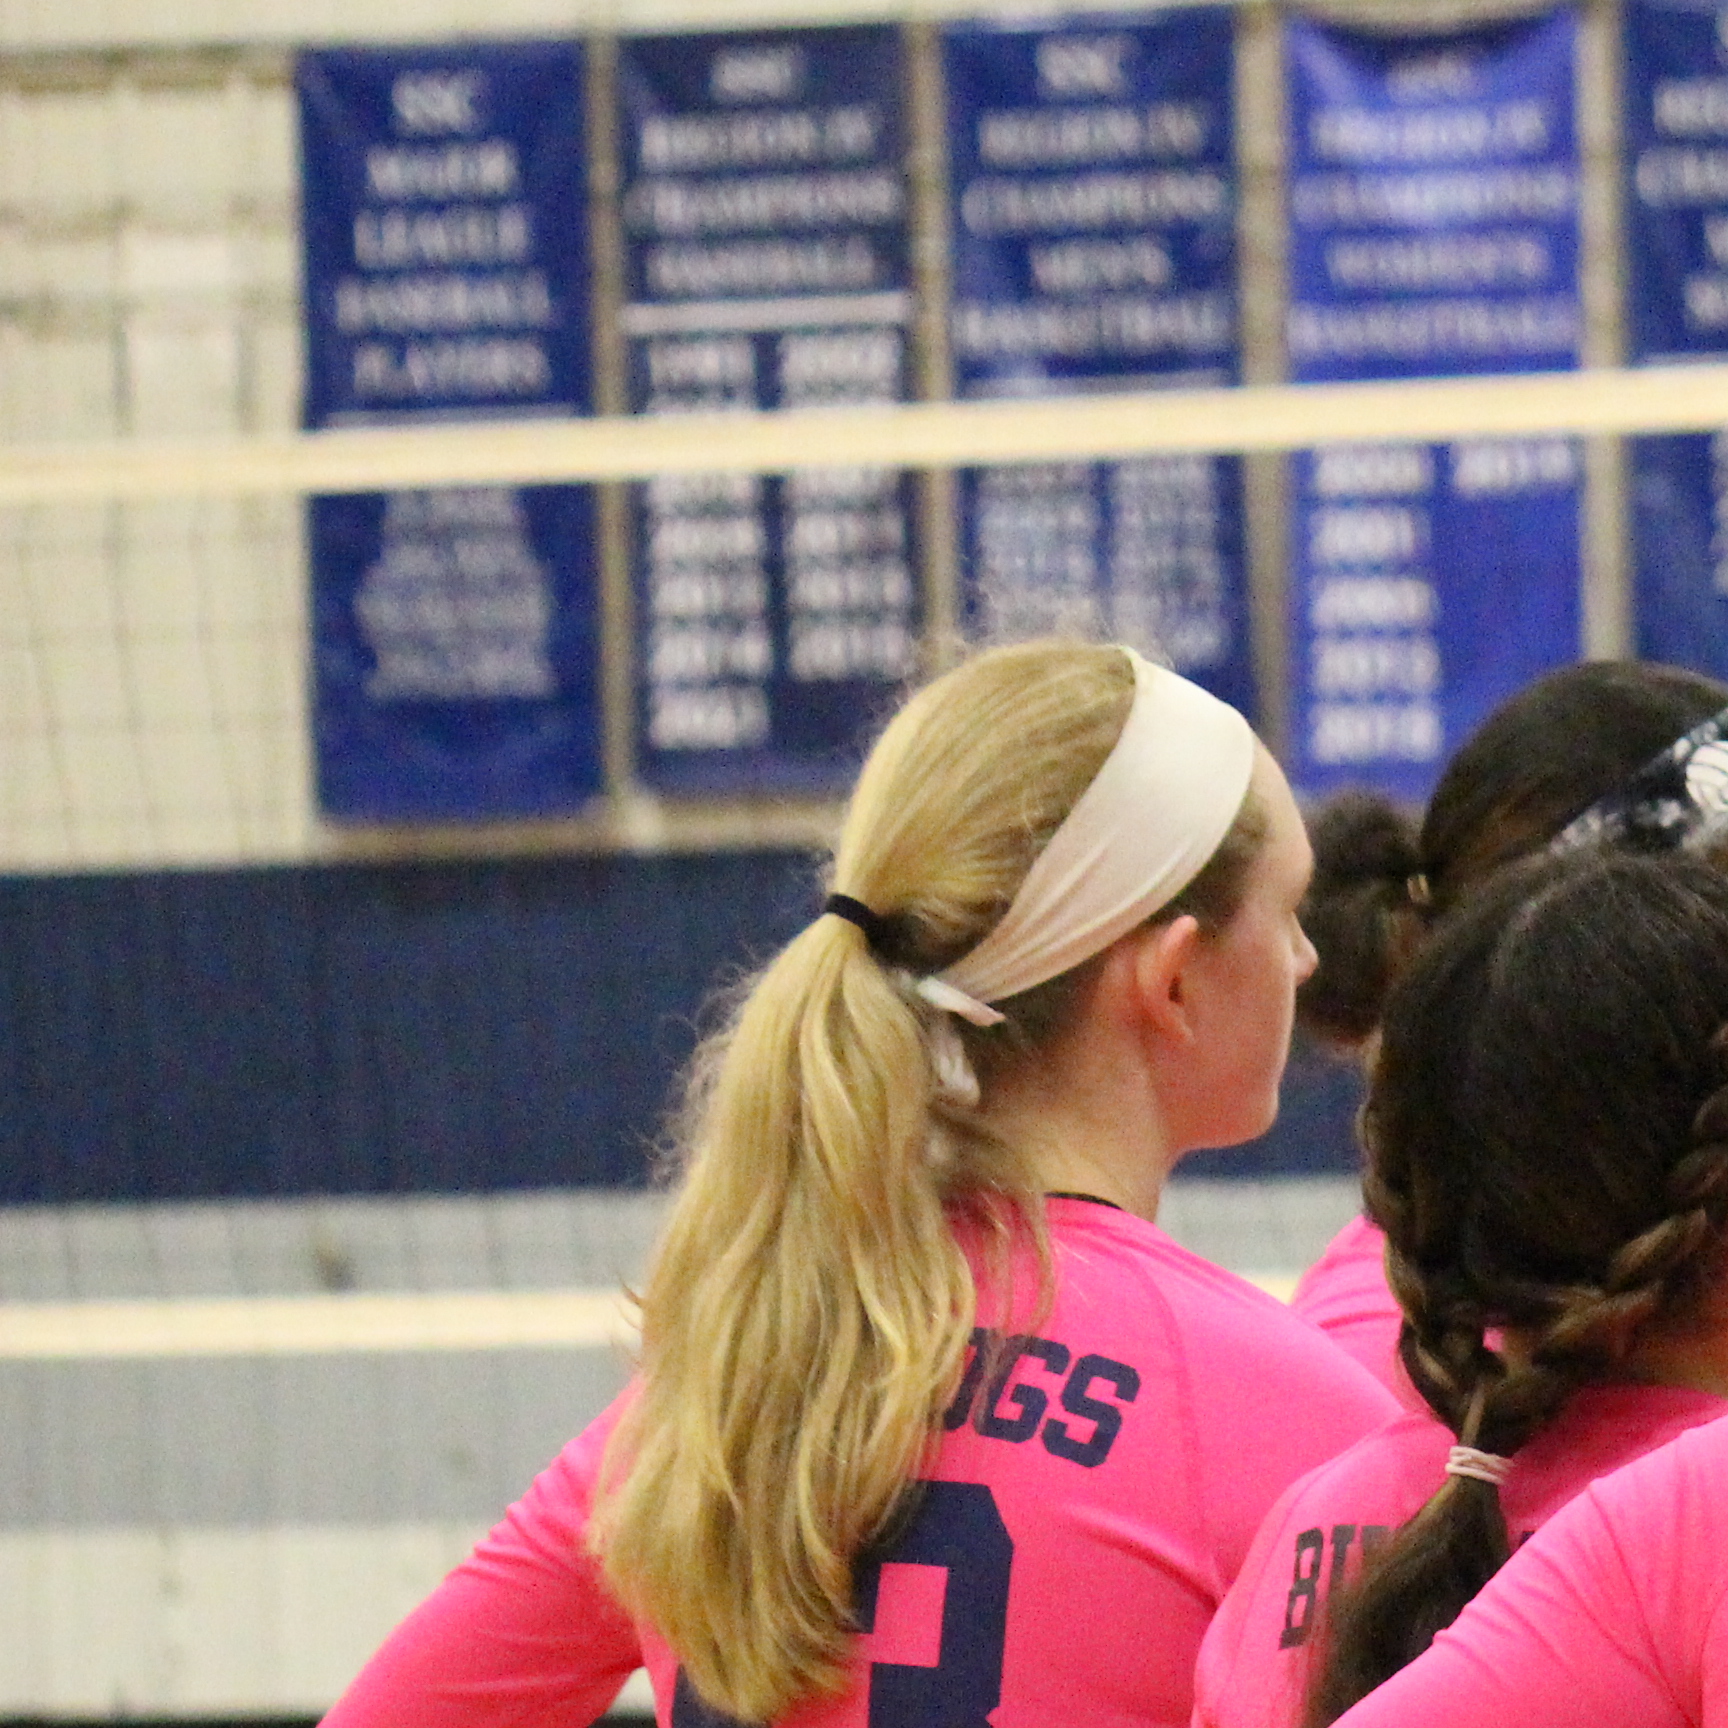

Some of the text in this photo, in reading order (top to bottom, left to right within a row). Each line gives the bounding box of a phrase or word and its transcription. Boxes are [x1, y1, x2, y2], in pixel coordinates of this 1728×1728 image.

[622, 166, 901, 234] CHAMPIONS
[961, 171, 1223, 236] CHAMPIONS
[1292, 168, 1571, 230] CHAMPIONS
[353, 207, 528, 268] LEAGUE
[335, 266, 552, 332] BASEBALL
[353, 338, 552, 397] PLAYERS
